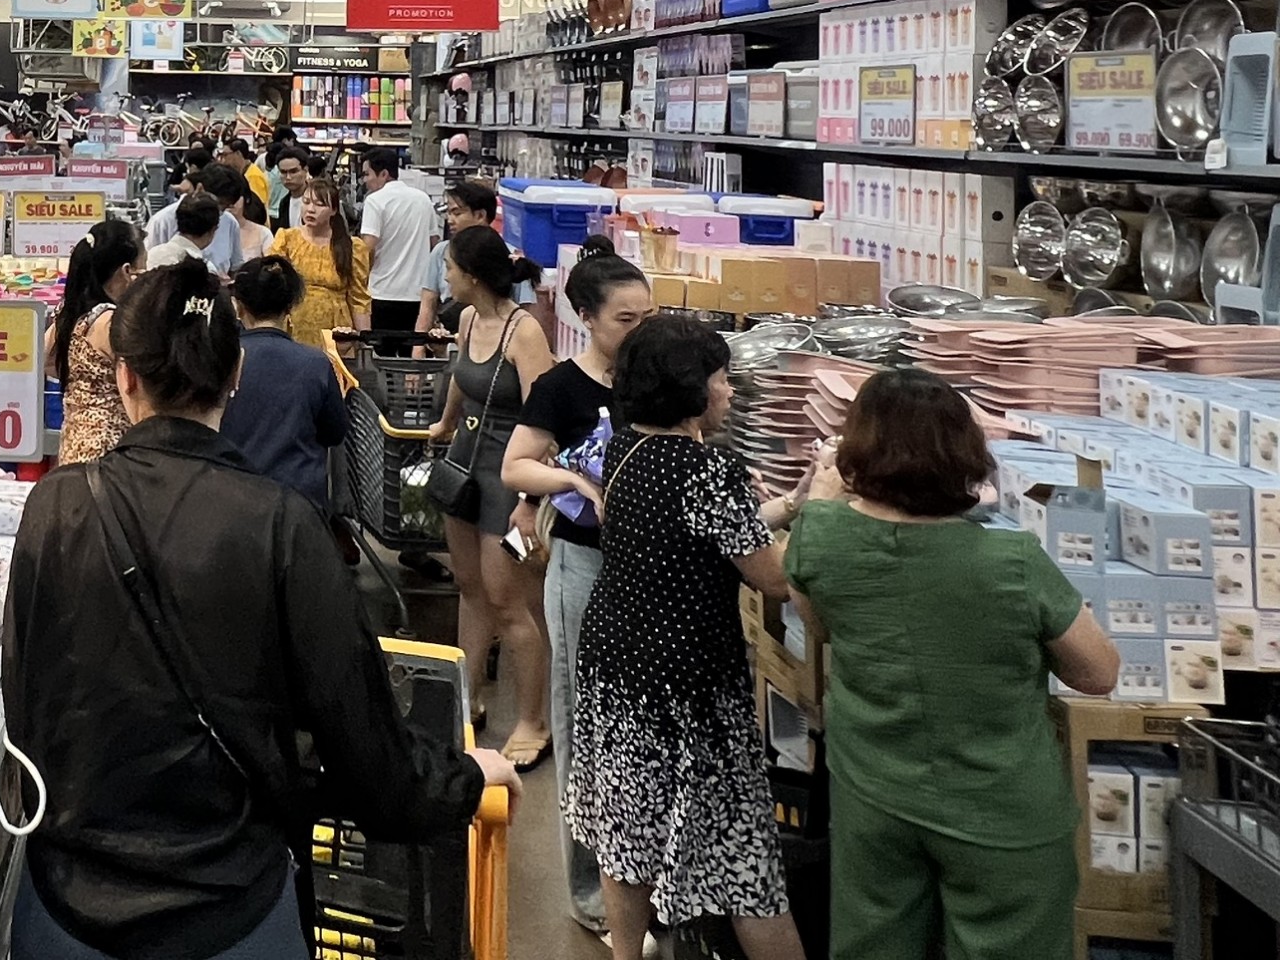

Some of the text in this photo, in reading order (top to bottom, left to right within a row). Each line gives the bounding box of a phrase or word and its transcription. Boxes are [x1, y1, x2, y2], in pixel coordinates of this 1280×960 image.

[388, 9, 454, 18] PROMOTION
[297, 56, 335, 67] FITNESS
[343, 58, 369, 68] YOGA
[870, 116, 910, 138] 99.000
[26, 200, 93, 217] SIÊU SALE
